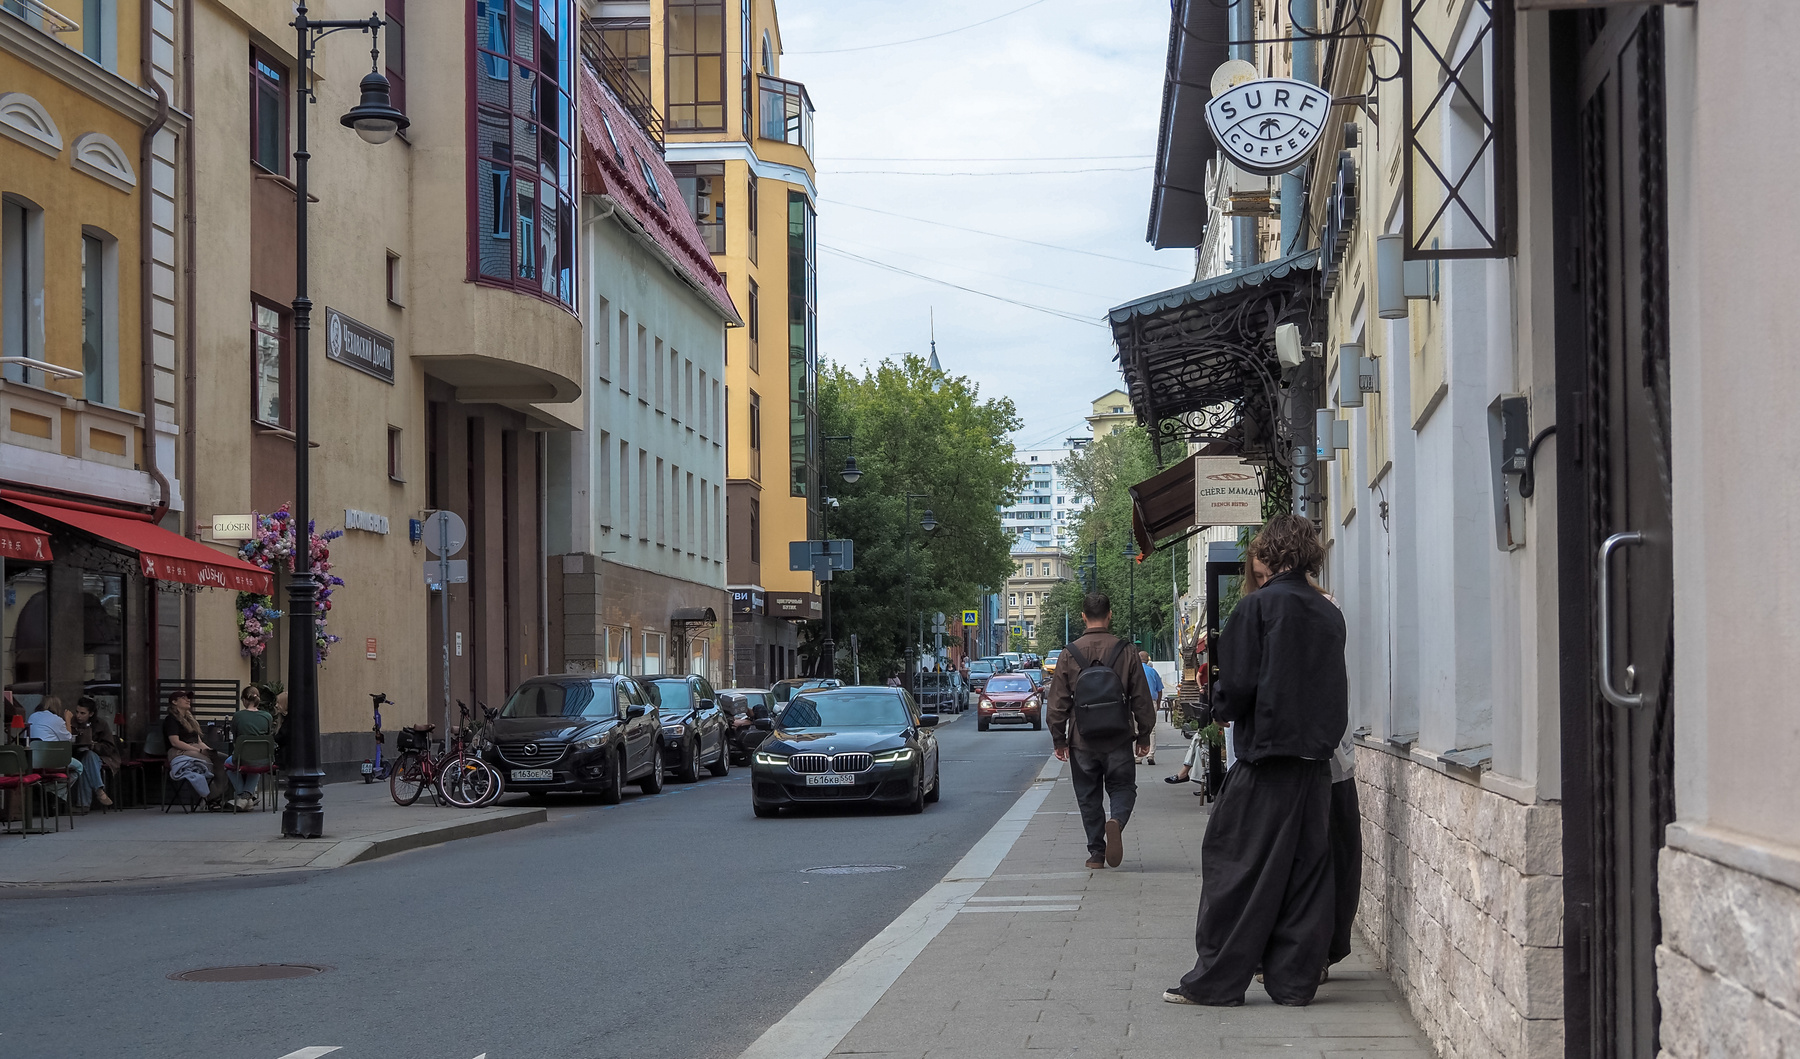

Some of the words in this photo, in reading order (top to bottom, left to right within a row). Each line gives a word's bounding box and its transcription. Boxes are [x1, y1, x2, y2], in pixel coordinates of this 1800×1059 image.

[1221, 89, 1317, 119] SURF
[1231, 128, 1309, 157] COFFEE
[1200, 487, 1226, 497] CHÈRE
[214, 522, 251, 532] CLÓSER
